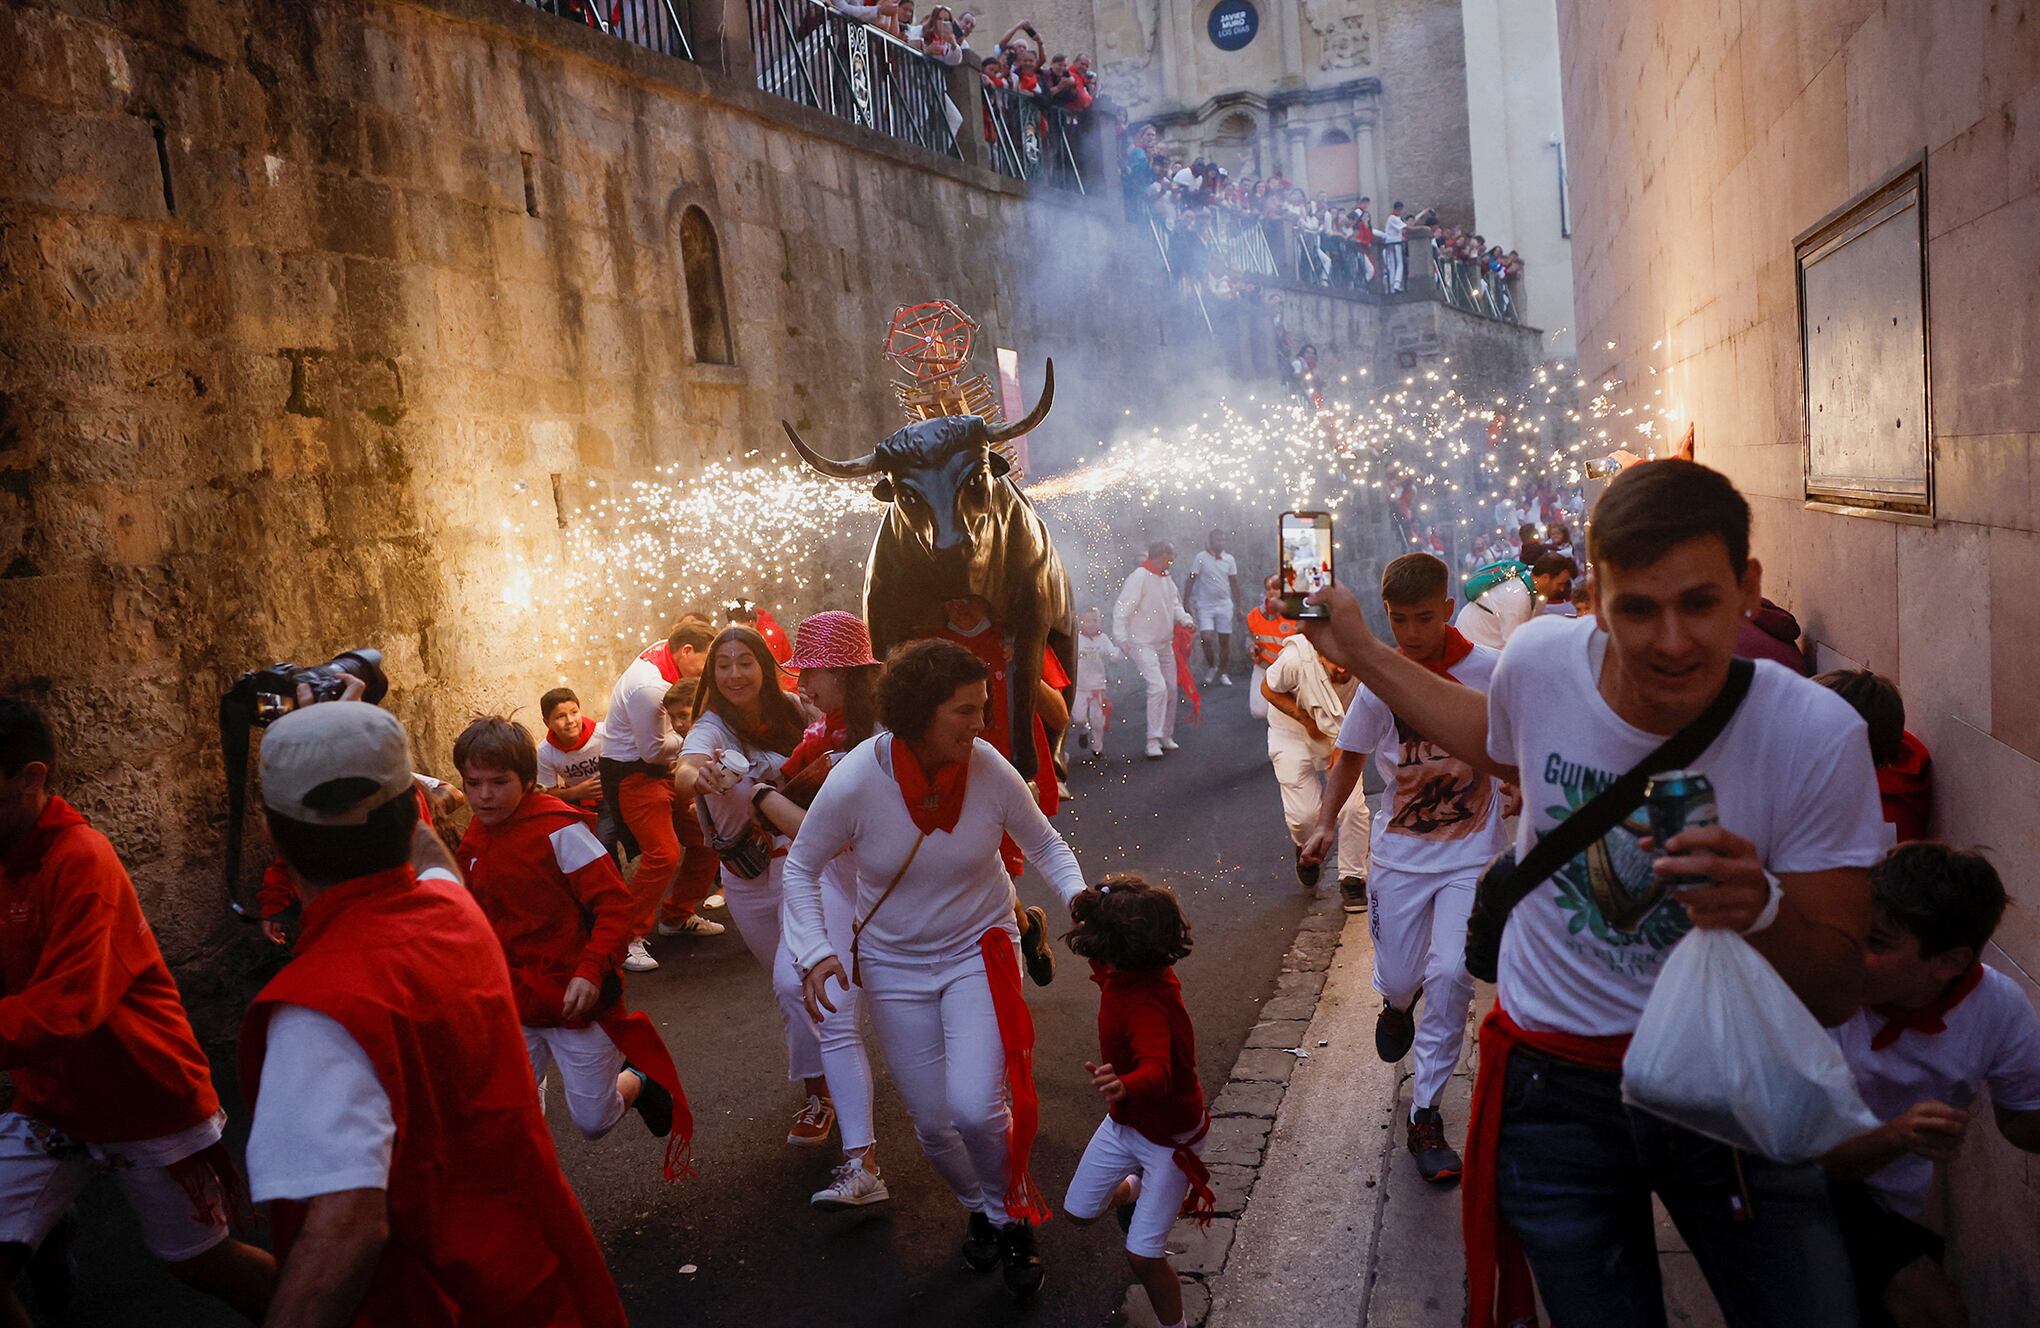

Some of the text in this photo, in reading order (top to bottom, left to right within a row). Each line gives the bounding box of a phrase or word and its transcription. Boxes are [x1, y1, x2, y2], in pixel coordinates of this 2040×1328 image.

[1220, 11, 1246, 22] JAVIER
[1222, 18, 1245, 28] MURO
[564, 757, 597, 773] JACK
[1544, 752, 1619, 793] GUINN
